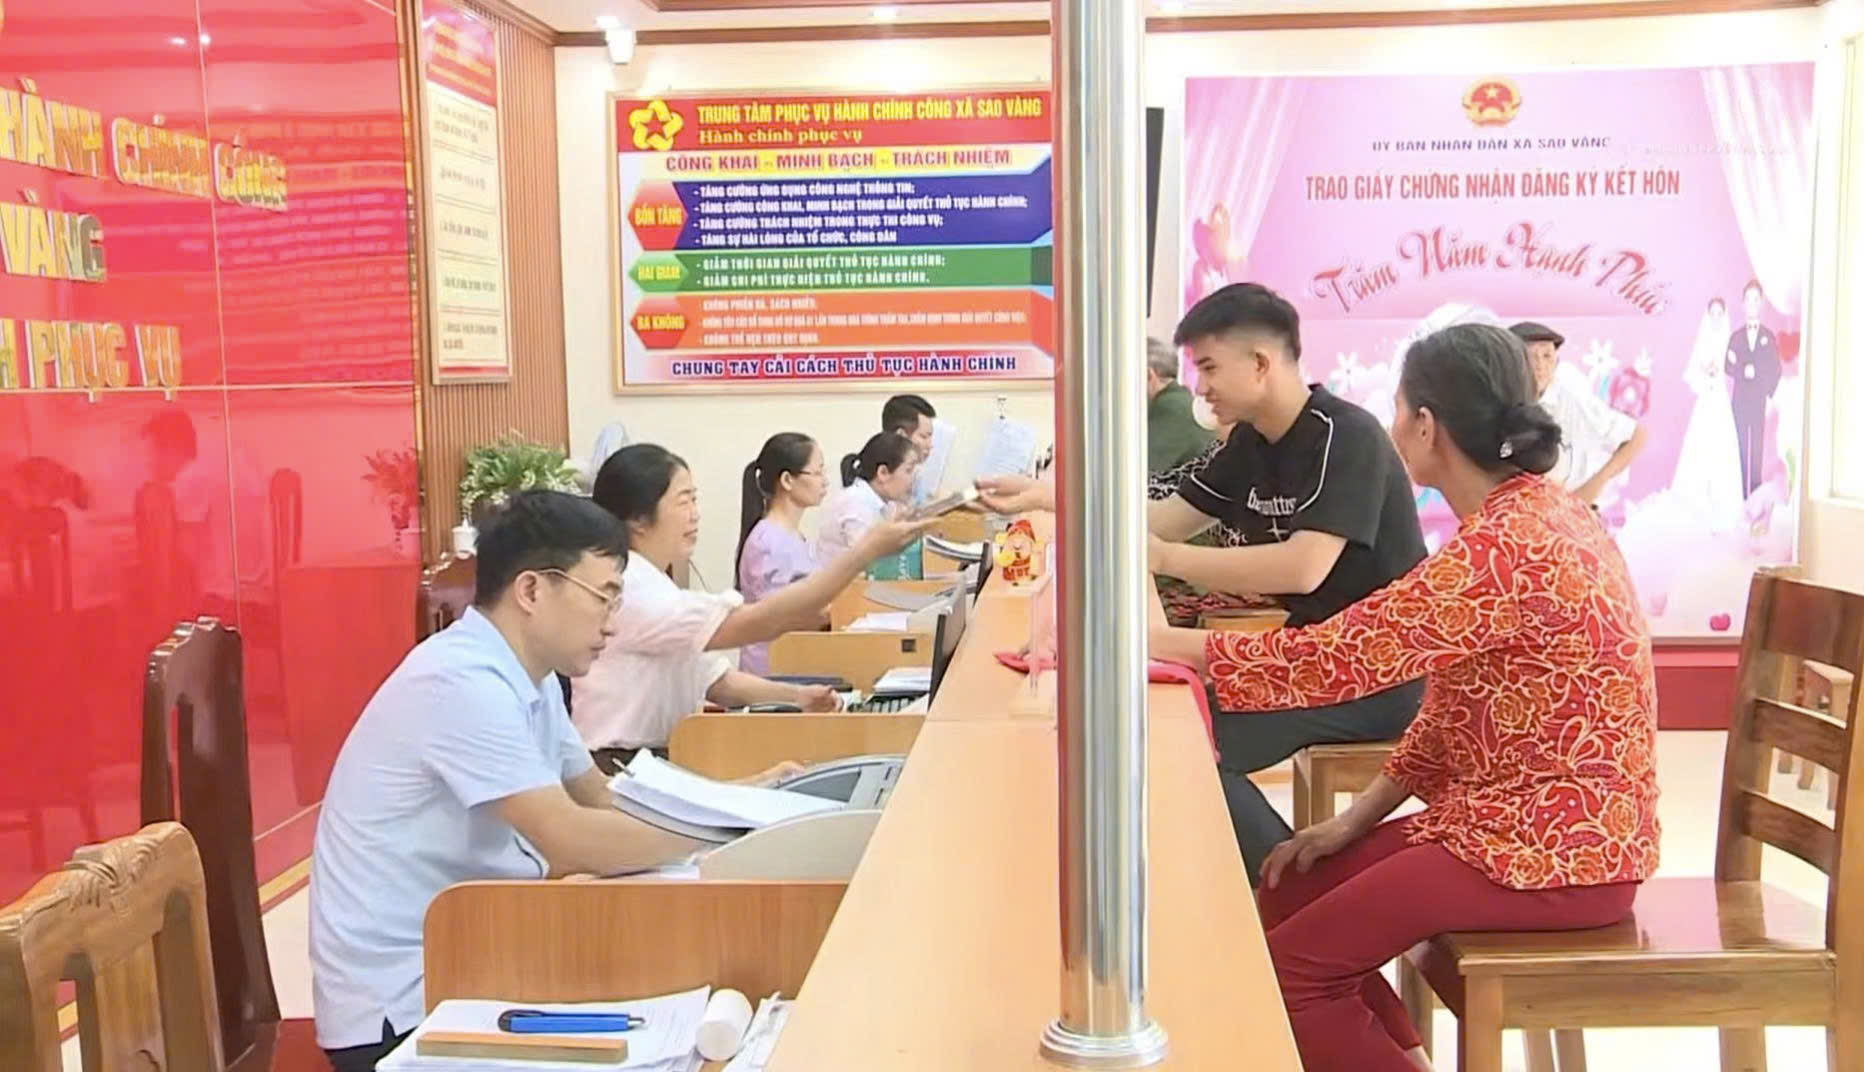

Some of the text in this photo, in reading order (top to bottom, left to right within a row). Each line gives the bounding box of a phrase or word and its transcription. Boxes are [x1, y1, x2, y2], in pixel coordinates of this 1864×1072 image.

[697, 103, 741, 124] TRUNG
[743, 99, 772, 123] TÂM
[775, 102, 810, 126] PHỤC
[812, 102, 831, 126] VỤ
[833, 97, 869, 121] HÀNH
[873, 97, 913, 120] CHÍNH
[916, 96, 951, 119] CÔNG
[976, 98, 1002, 118] SAO
[1006, 95, 1042, 117] VÀNG
[700, 127, 862, 145] Hành chính phục vụ
[1395, 140, 1426, 151] BAN
[1538, 138, 1566, 149] SAO
[666, 154, 713, 171] CÔNG
[719, 155, 758, 170] KHAI
[776, 154, 821, 169] MINH
[828, 153, 874, 171] BẠCH
[893, 149, 947, 166] TRÁCH
[953, 148, 1010, 167] NHIỆM
[1306, 162, 1680, 205] TRAO GIẤY CHỨNG NHẬN ĐĂNG KÝ KẾT HÔN
[0, 188, 105, 283] VÀNG
[1398, 225, 1488, 277] Năm
[25, 320, 129, 403] PHỤC
[134, 324, 184, 401] VỤ
[672, 352, 1017, 377] CHUNG TAY CẢI CÁCH THỦ TỤC HÀNH CHÍNH
